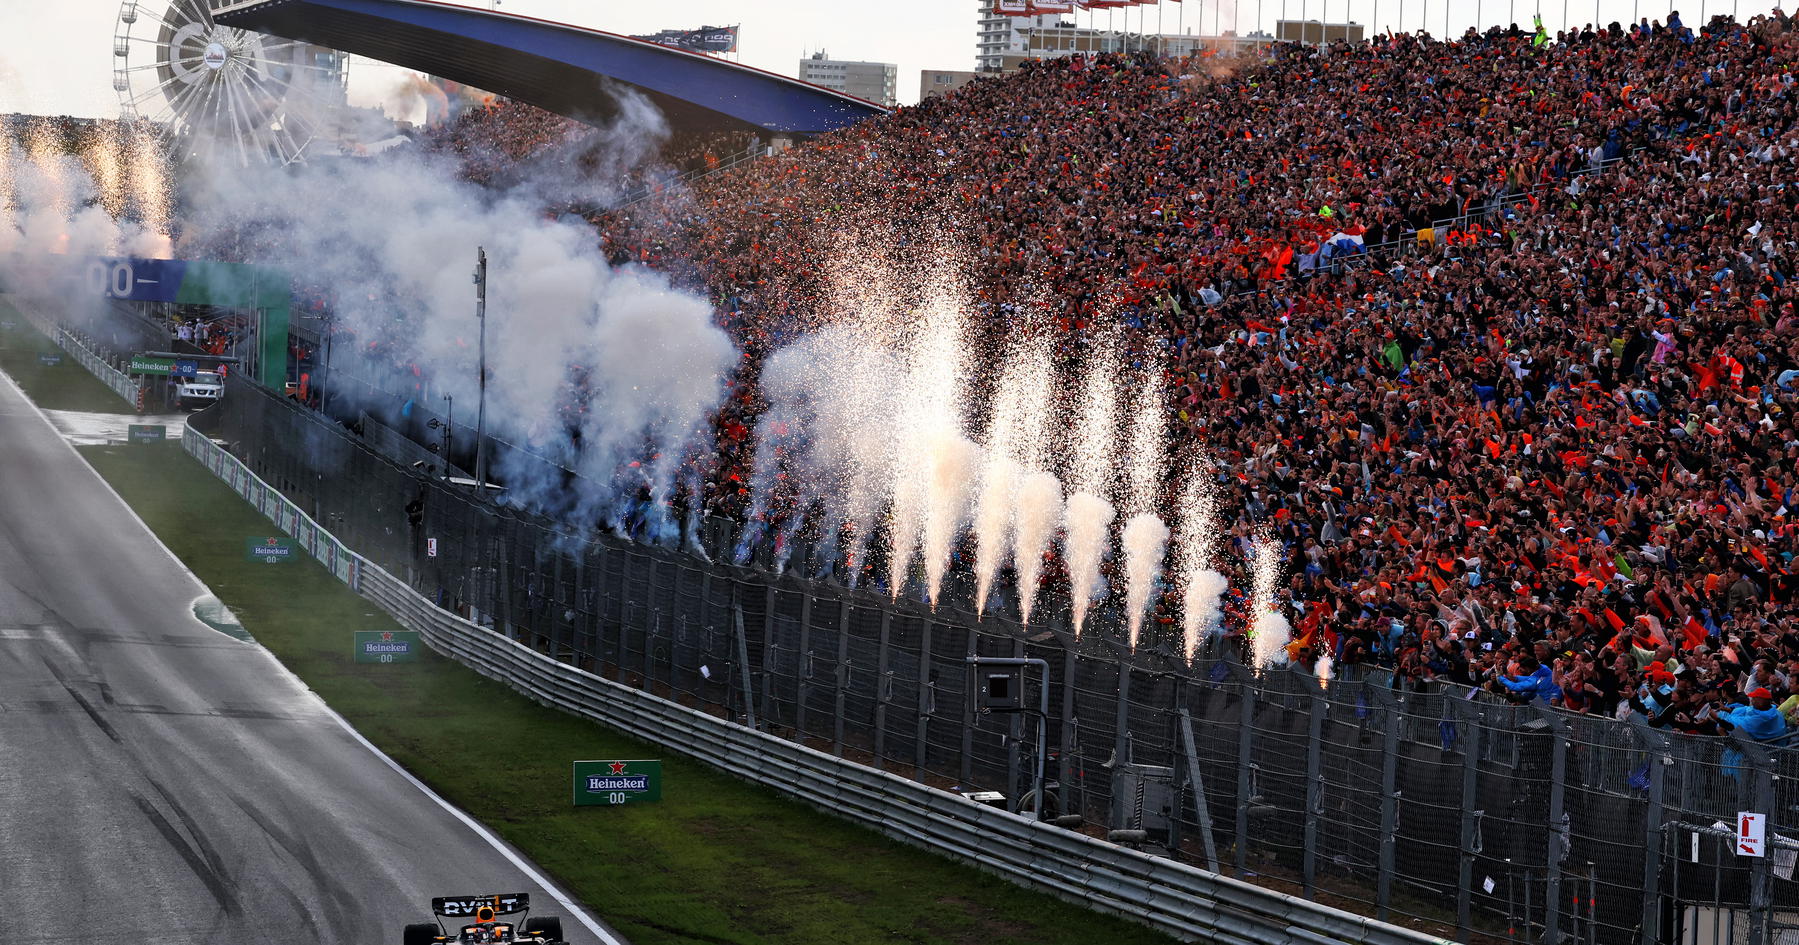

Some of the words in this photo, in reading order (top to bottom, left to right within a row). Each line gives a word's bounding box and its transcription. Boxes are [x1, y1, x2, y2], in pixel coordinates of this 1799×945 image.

[131, 361, 169, 371] Heineken
[255, 547, 289, 555] Heineken
[366, 643, 407, 652] Heineken
[589, 778, 645, 789] Heineken
